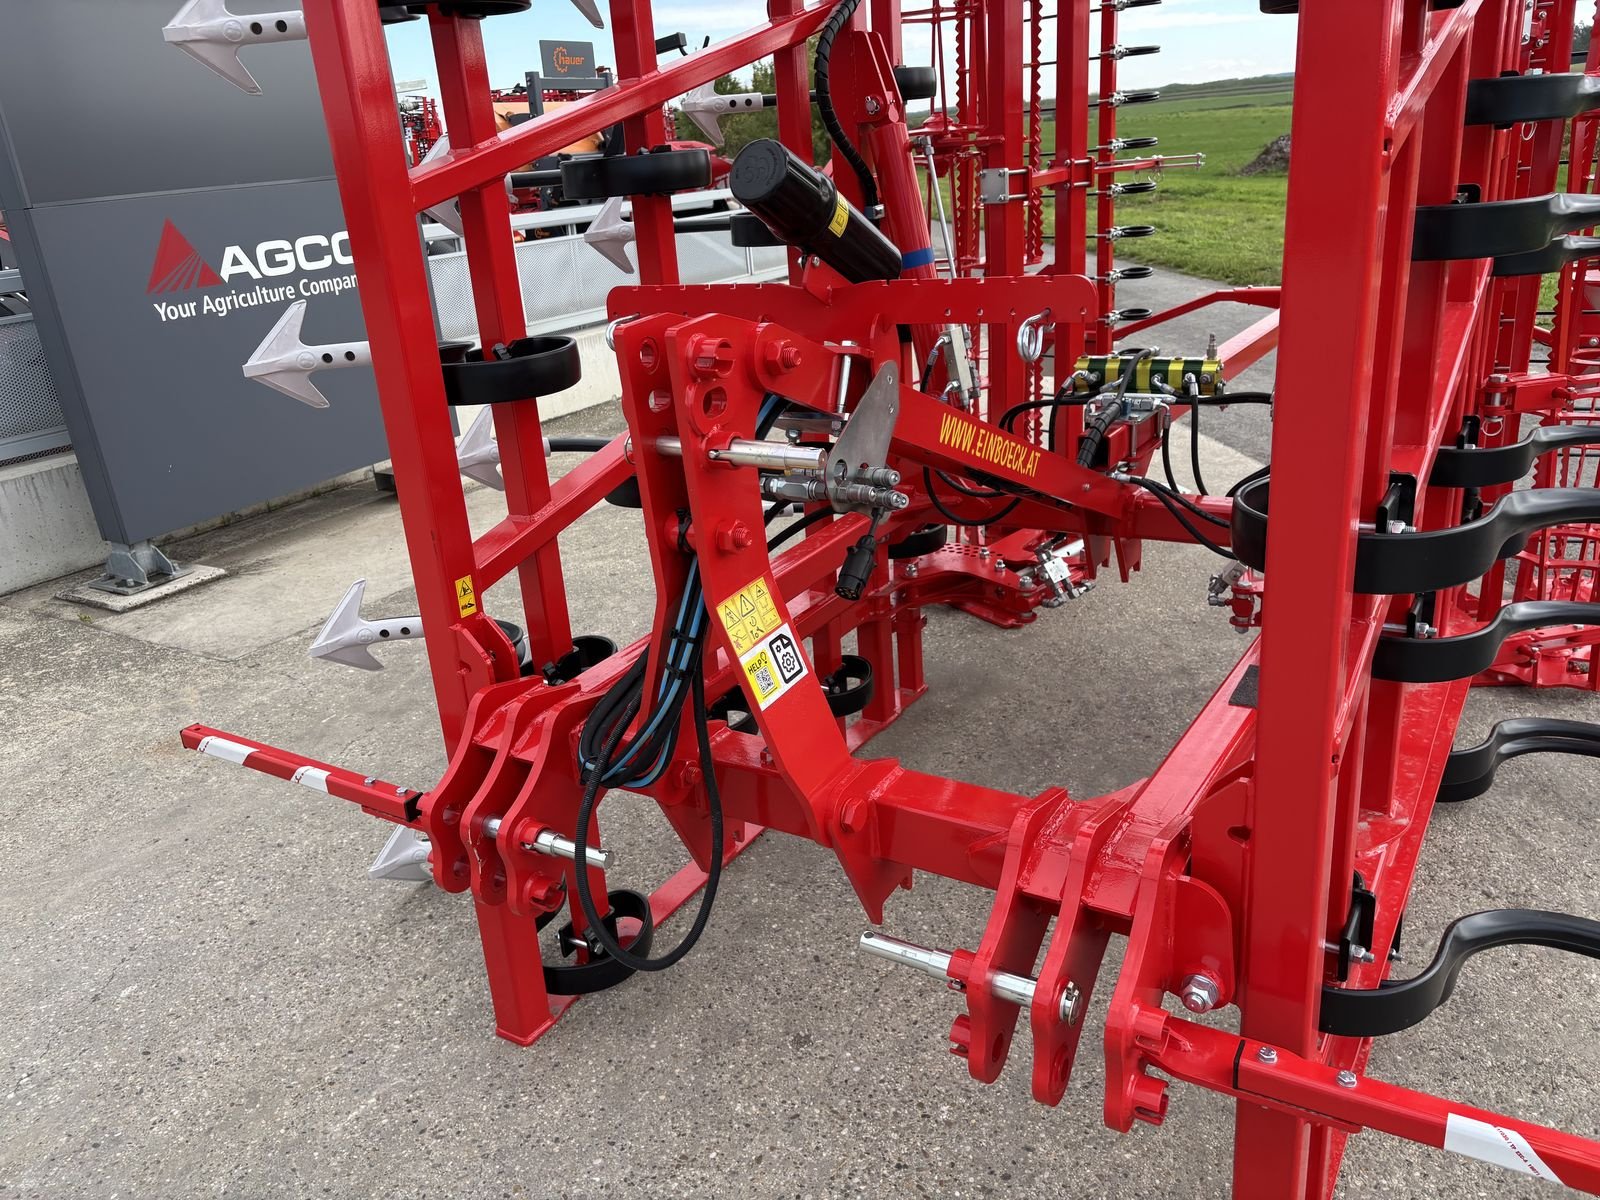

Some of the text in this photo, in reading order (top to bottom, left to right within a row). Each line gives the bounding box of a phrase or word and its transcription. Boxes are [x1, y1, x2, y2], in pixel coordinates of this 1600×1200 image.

[559, 52, 584, 65] hauer
[154, 273, 359, 322] Your Agriculture Compan
[940, 412, 1041, 478] WWW.EINBOECK.AT
